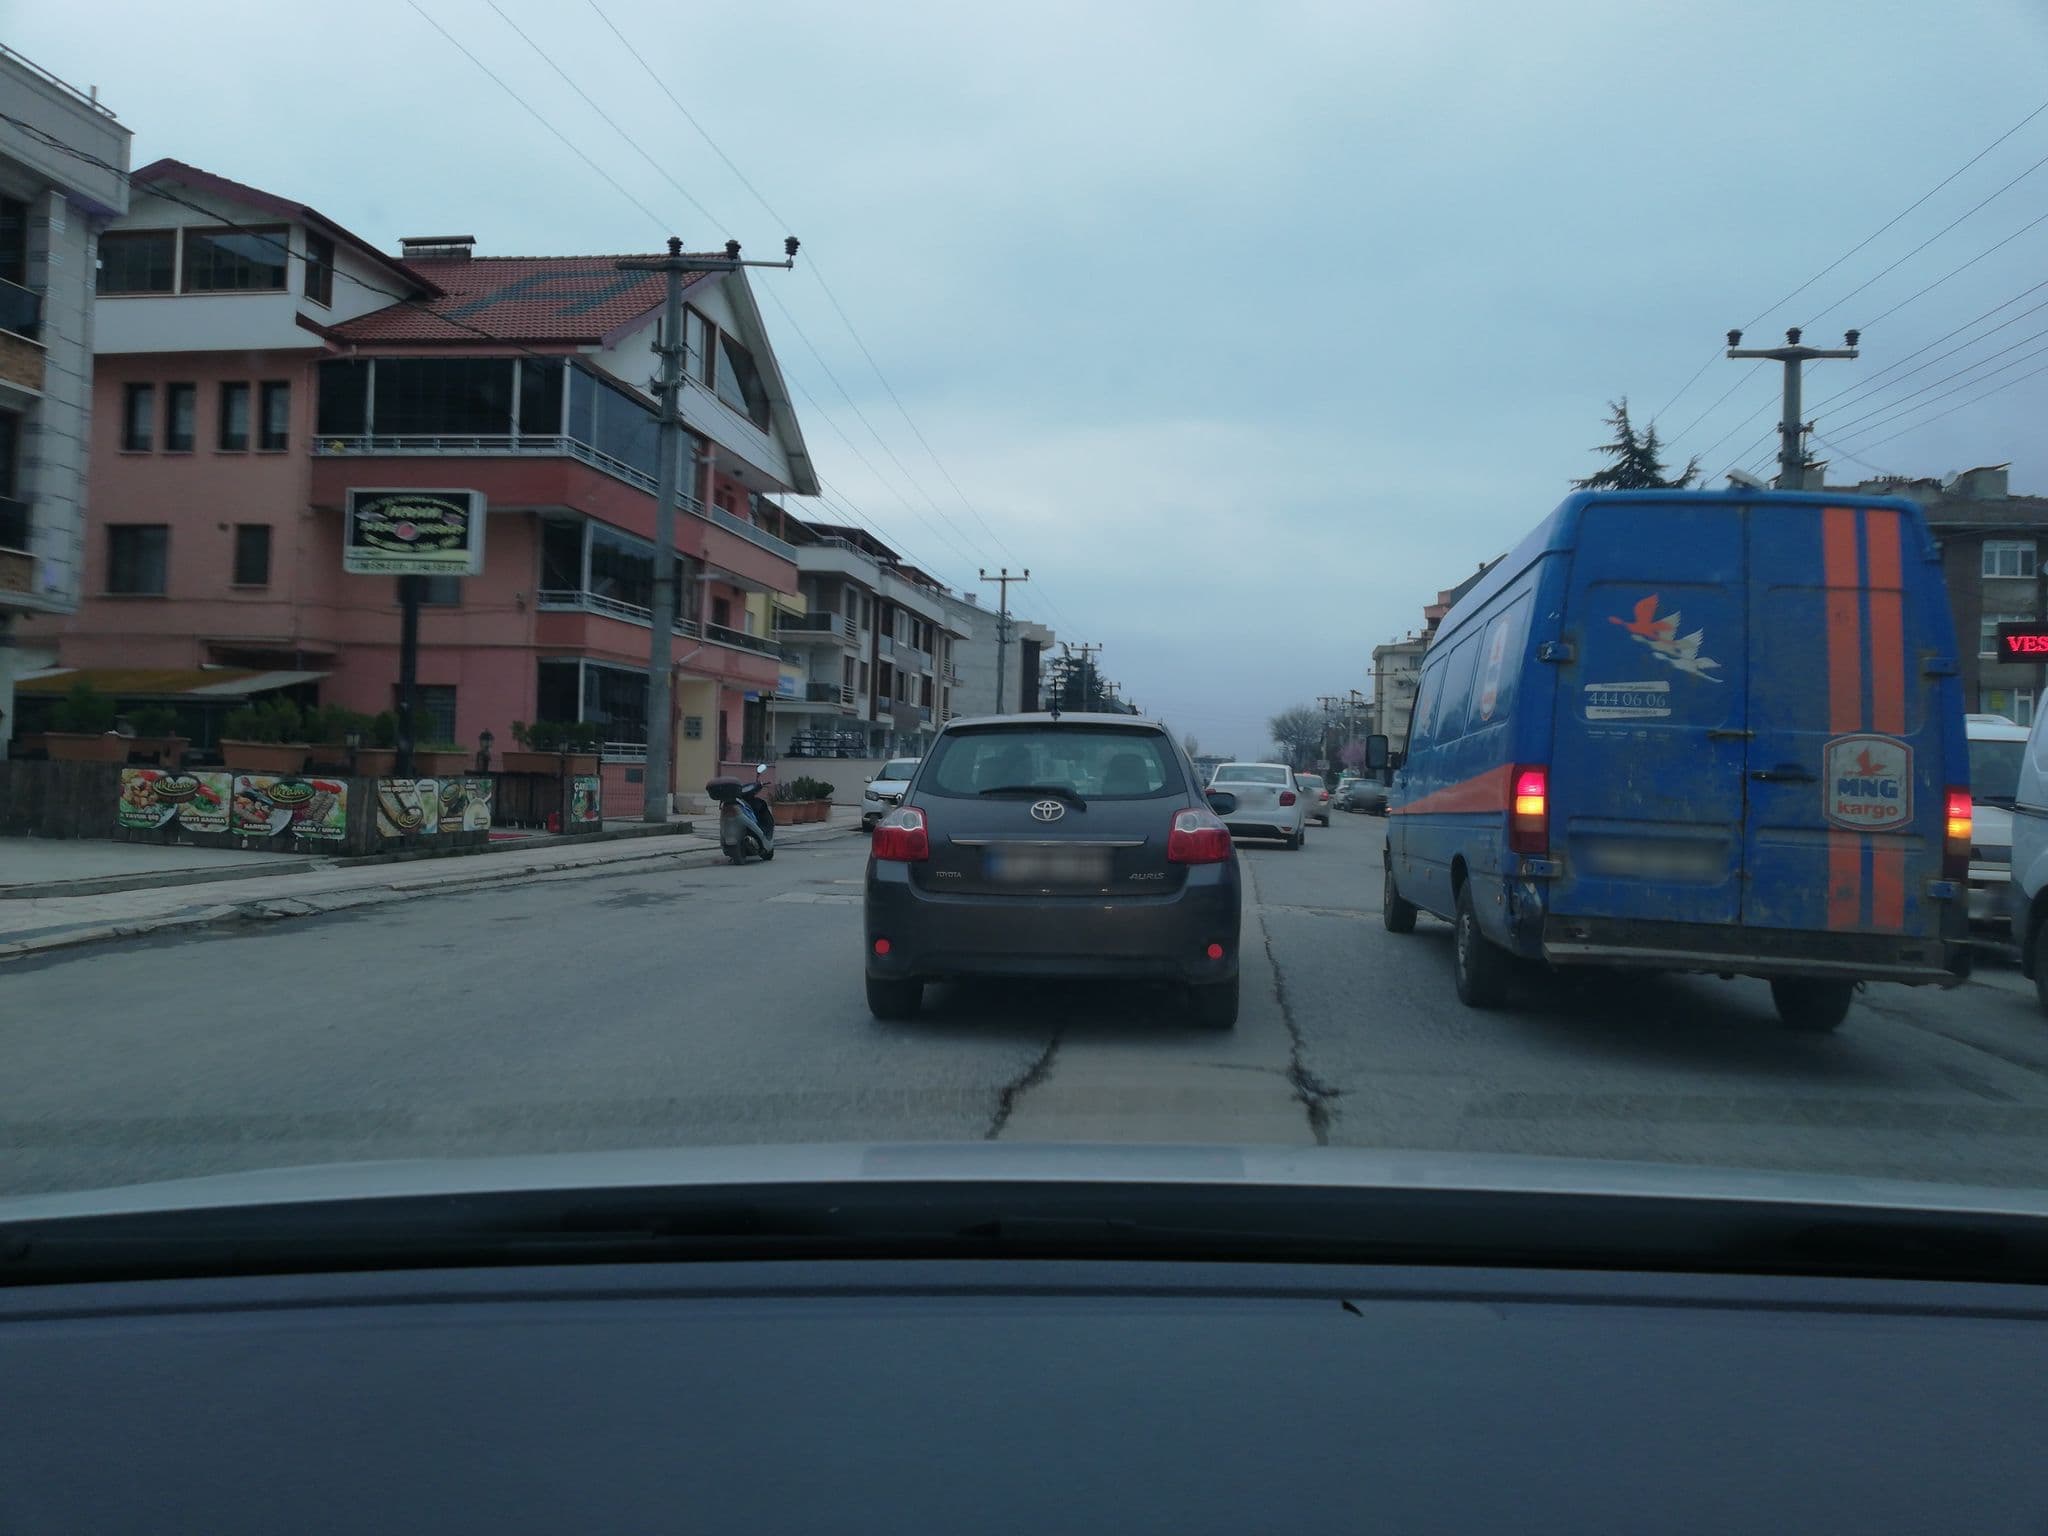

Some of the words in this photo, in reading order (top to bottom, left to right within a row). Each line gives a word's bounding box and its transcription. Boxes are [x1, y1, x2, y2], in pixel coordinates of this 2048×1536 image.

[2006, 636, 2048, 652] VES
[1590, 692, 1619, 705] 444
[1622, 692, 1642, 706] 06
[1646, 693, 1666, 707] 06
[1837, 778, 1898, 799] MNG
[1837, 800, 1898, 819] kargo
[935, 871, 962, 879] TOYOTA
[1128, 872, 1165, 880] AURIS
